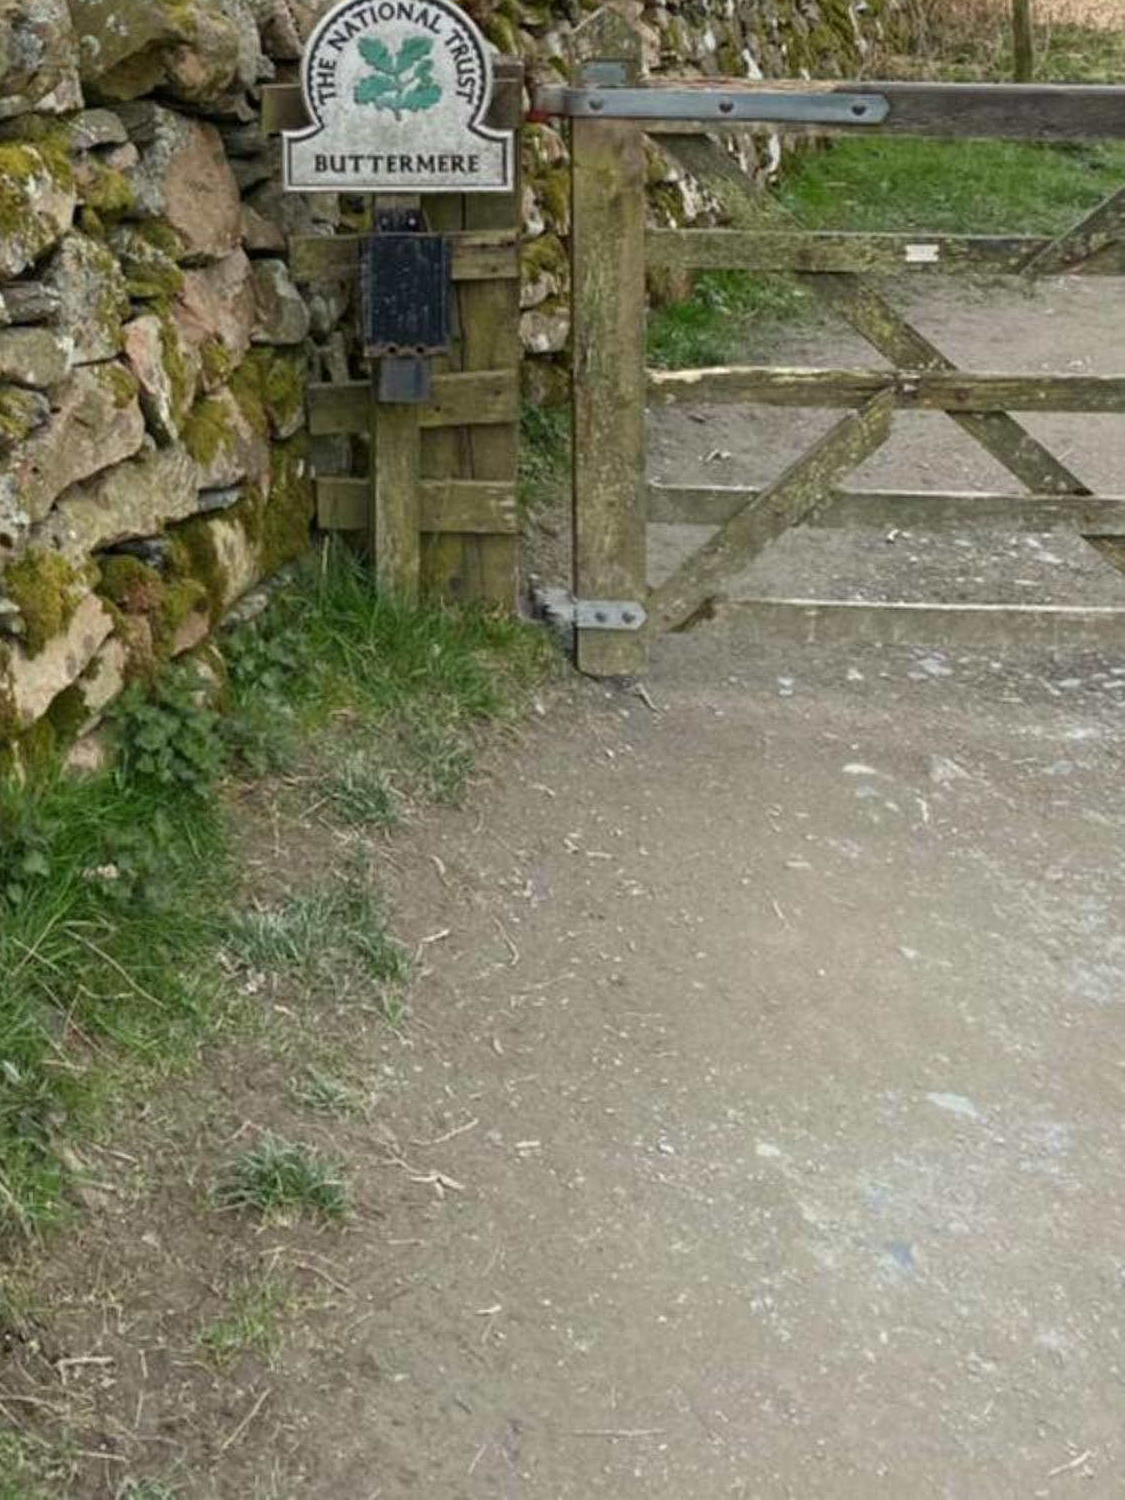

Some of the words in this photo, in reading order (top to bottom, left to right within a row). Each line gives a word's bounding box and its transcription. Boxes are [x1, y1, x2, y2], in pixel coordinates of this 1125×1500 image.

[317, 57, 338, 106] THE
[328, 2, 442, 51] NATIONAL
[444, 29, 475, 105] TRUST
[315, 155, 479, 174] BUTTERMERE
